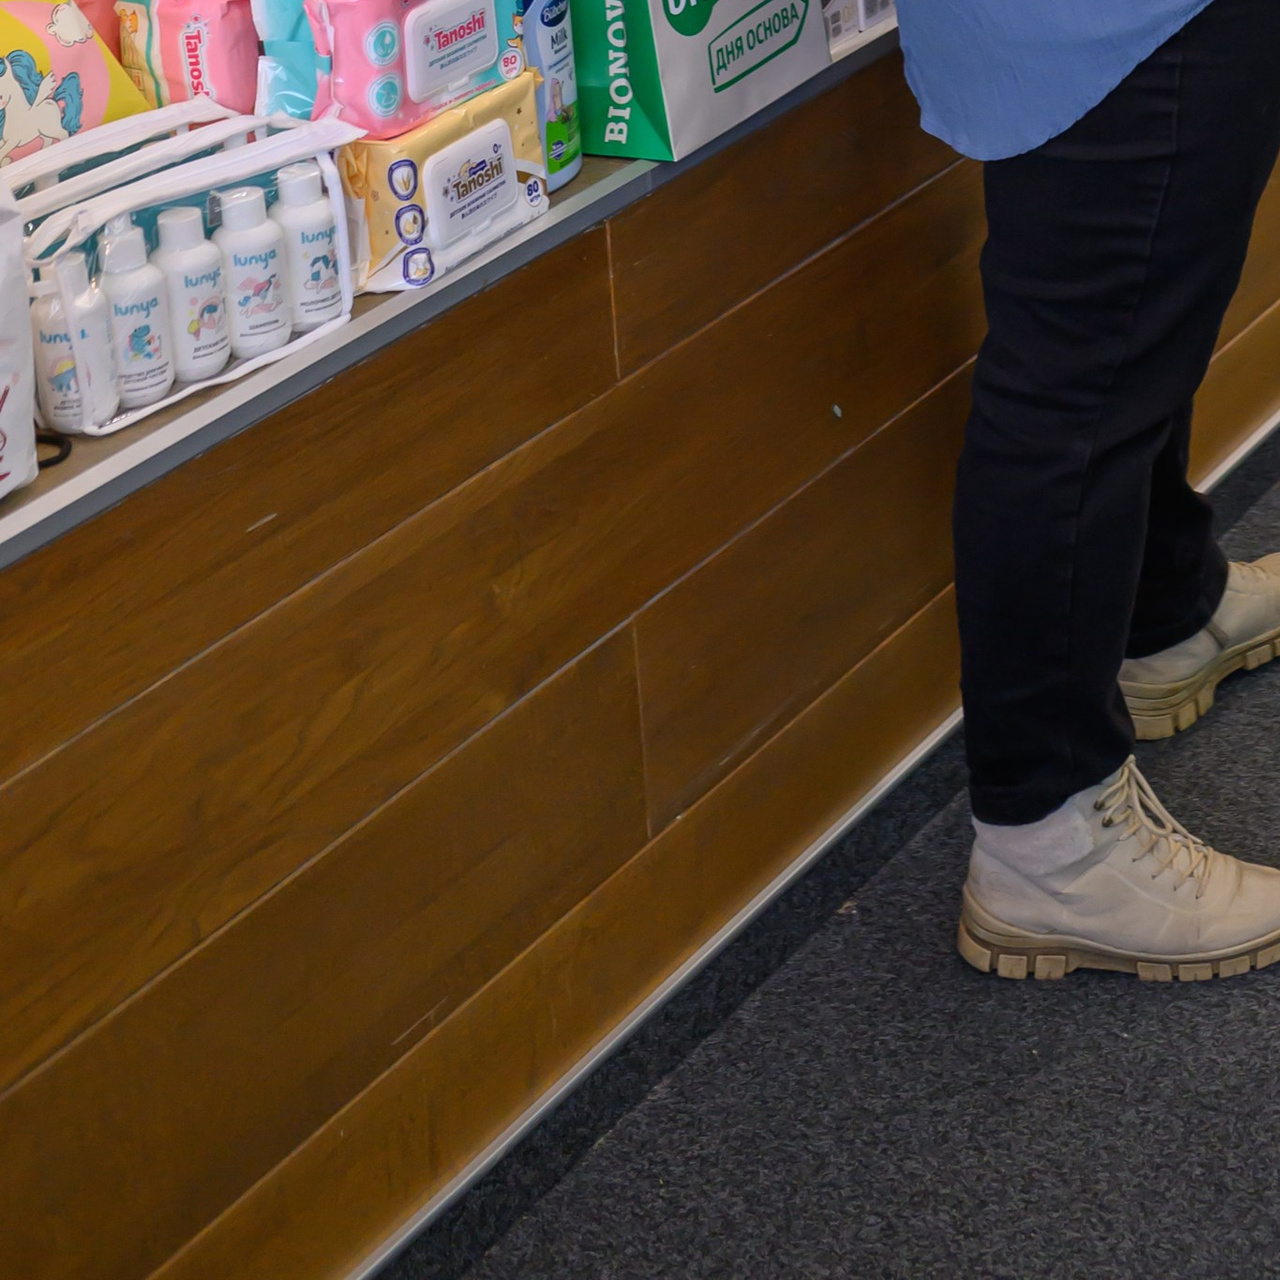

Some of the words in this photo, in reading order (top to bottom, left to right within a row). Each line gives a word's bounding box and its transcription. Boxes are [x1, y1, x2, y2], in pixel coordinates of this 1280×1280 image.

[550, 28, 569, 50] Milk
[716, 37, 743, 77] ДНЯ
[744, 6, 801, 52] ОСНОВА
[502, 55, 518, 68] 80
[526, 181, 540, 196] 80
[233, 249, 277, 270] lunya
[114, 297, 159, 319] lunya
